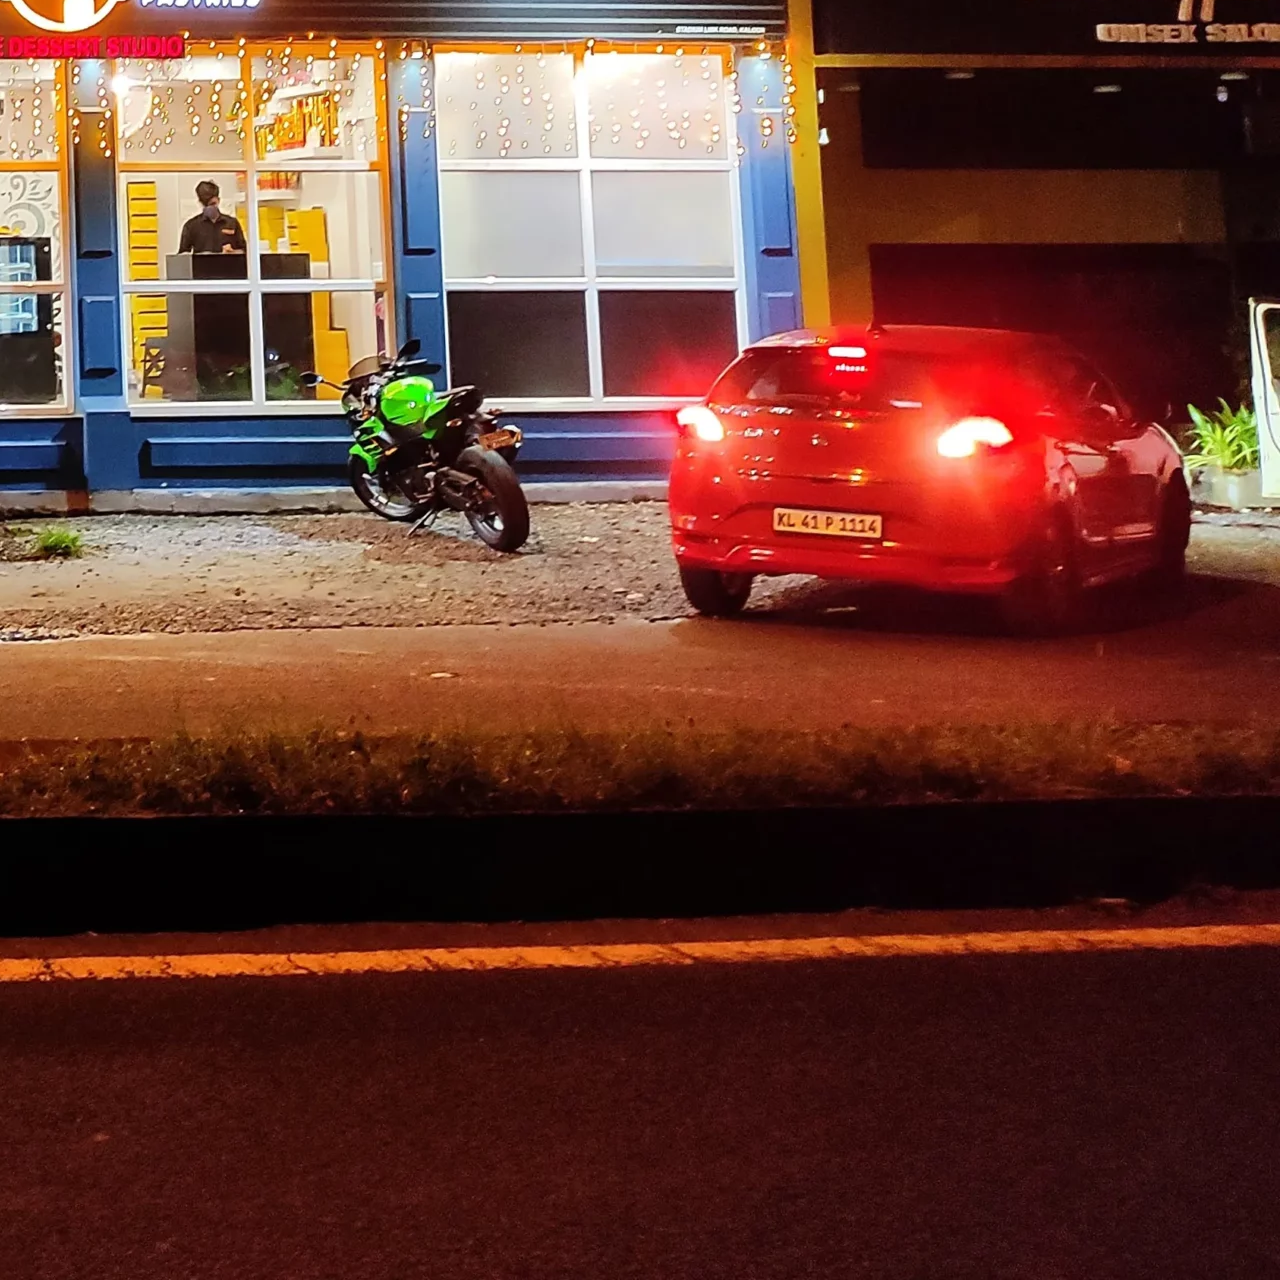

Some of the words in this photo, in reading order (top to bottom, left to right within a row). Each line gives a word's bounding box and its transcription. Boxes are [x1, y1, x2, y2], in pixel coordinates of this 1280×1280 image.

[1096, 23, 1198, 43] UNISEX
[8, 35, 103, 57] DESSERT
[106, 35, 184, 57] STUDIO
[777, 512, 796, 528] KL
[801, 514, 819, 530] 41
[825, 516, 834, 530] P
[839, 517, 878, 534] 1114
